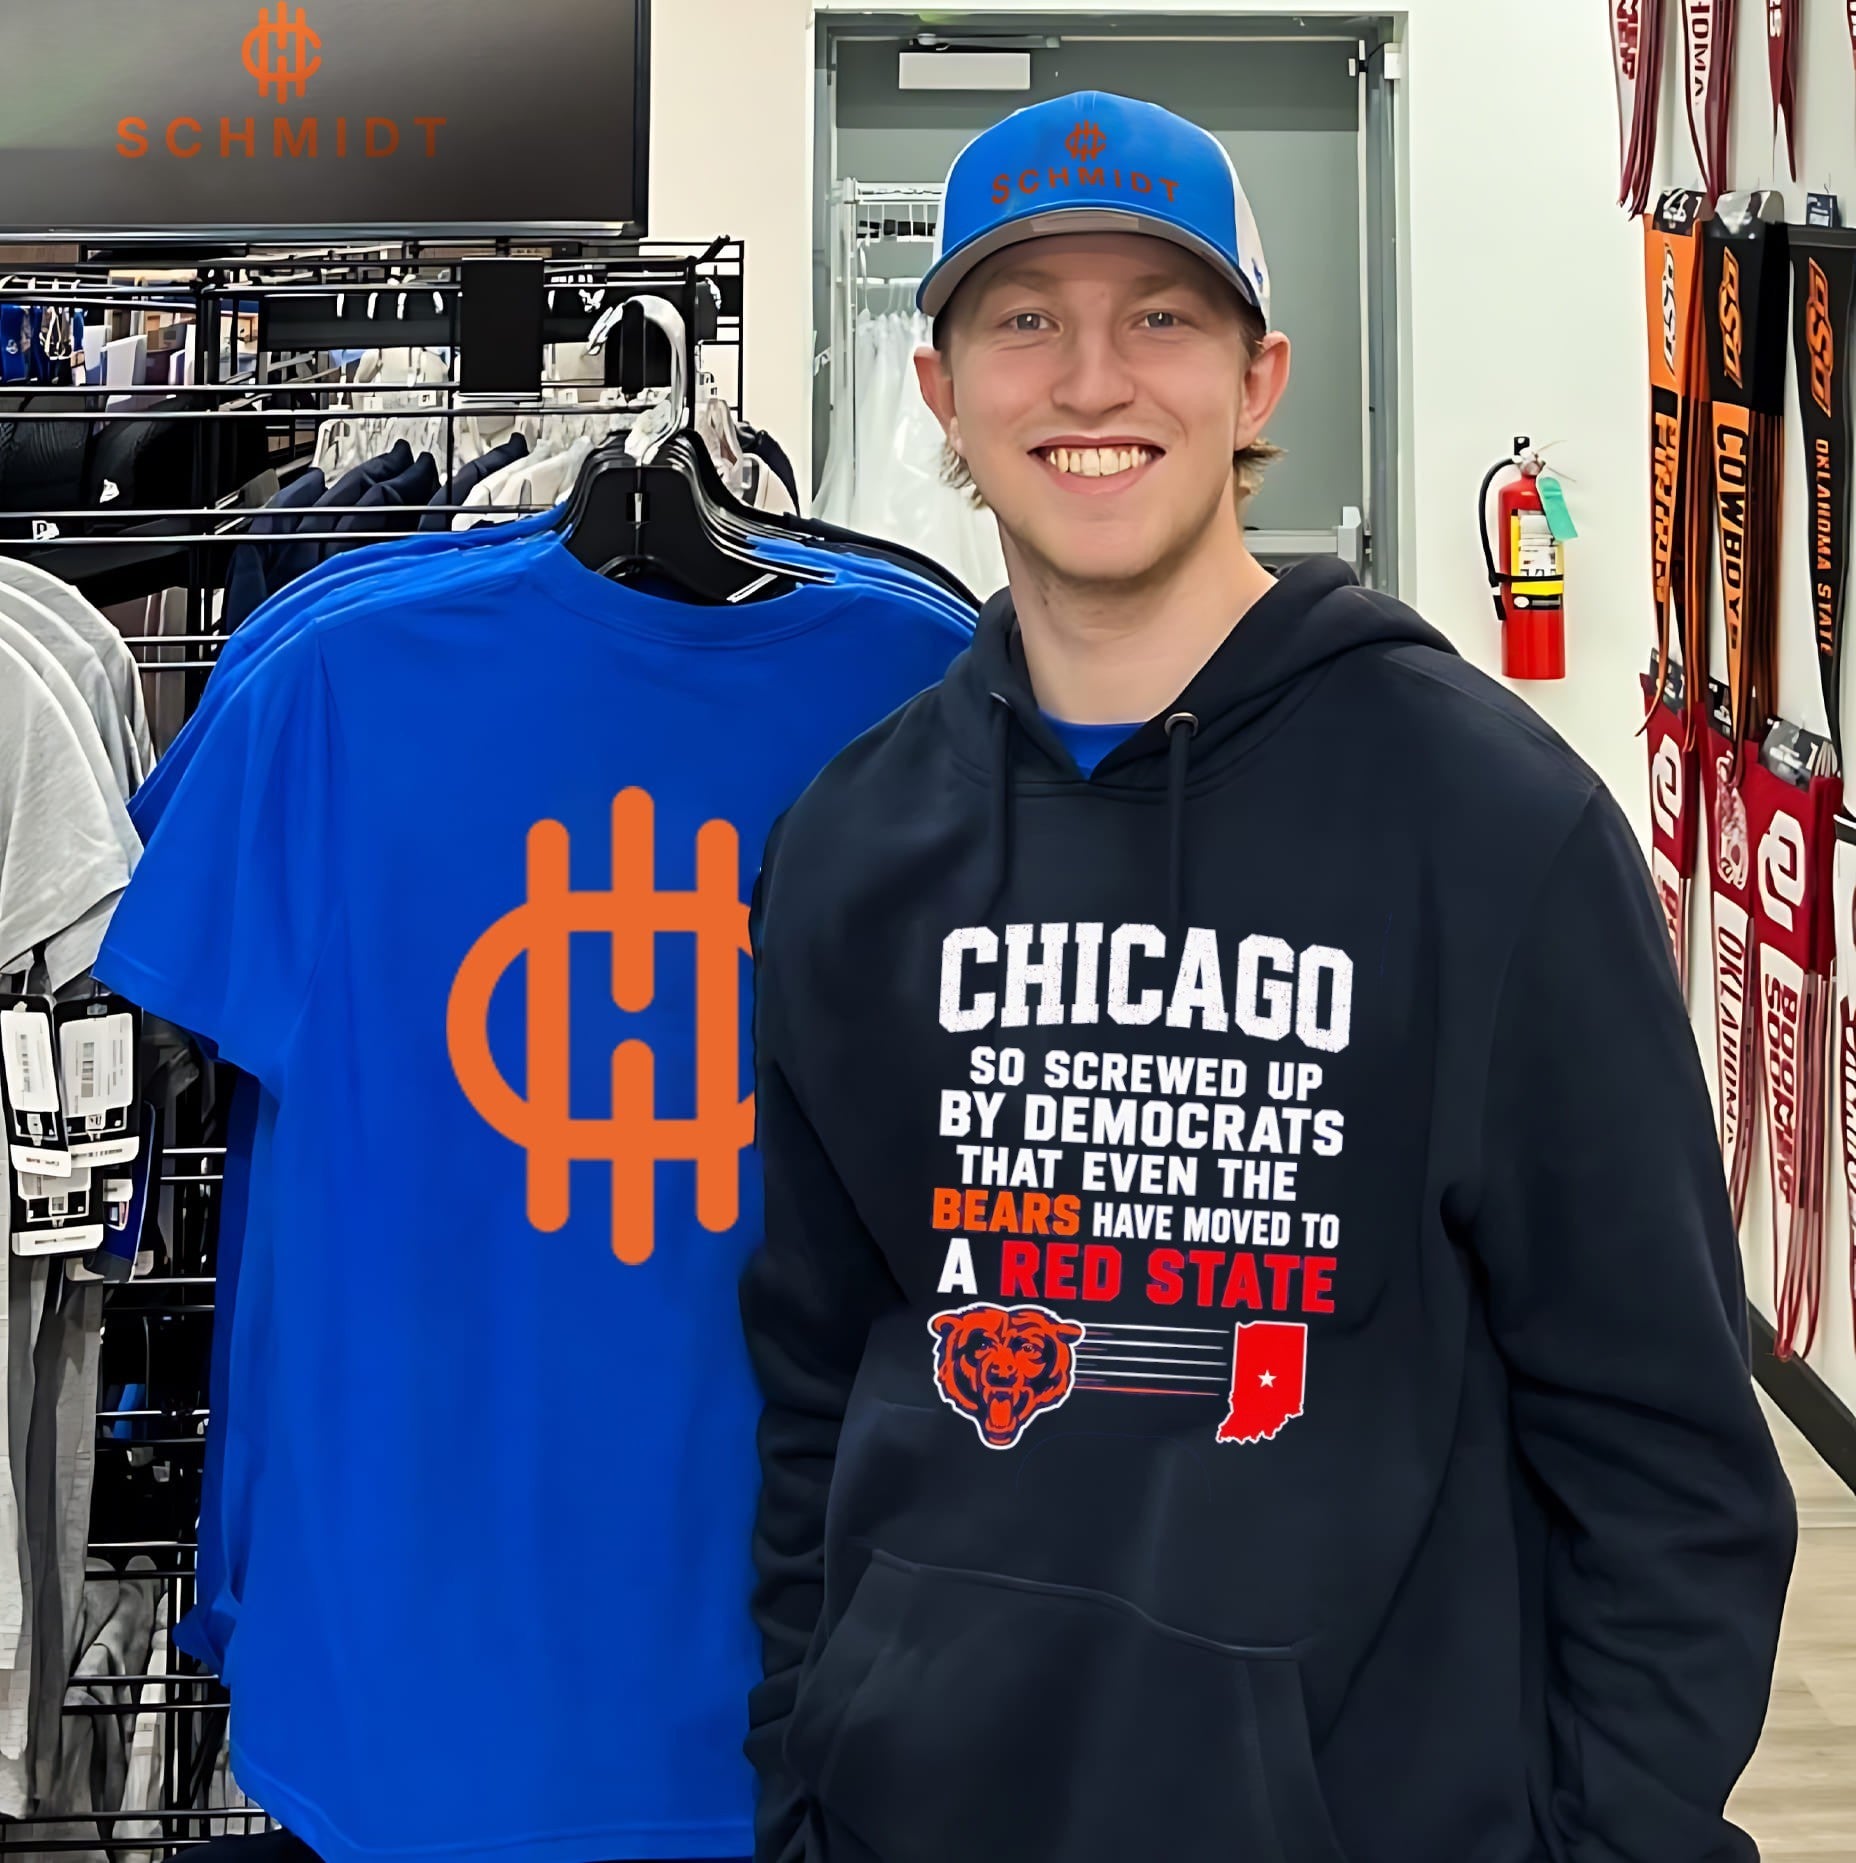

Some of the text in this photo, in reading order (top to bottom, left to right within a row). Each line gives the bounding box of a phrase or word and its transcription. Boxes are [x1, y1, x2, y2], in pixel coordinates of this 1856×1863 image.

[115, 115, 448, 159] SCHMIDT
[991, 166, 1180, 205] SCHMIDT
[1815, 438, 1832, 570] OKLAHOMA
[938, 921, 1354, 1054] CHICAGO
[969, 1045, 1323, 1102] SO SCREWED UP
[939, 1088, 1345, 1157] BY DEMOCRATS
[955, 1144, 1298, 1202] THAT EVEN THE
[931, 1187, 1340, 1250] BEARS HAVE MOVED TO
[936, 1237, 1338, 1314] A RED STATE
